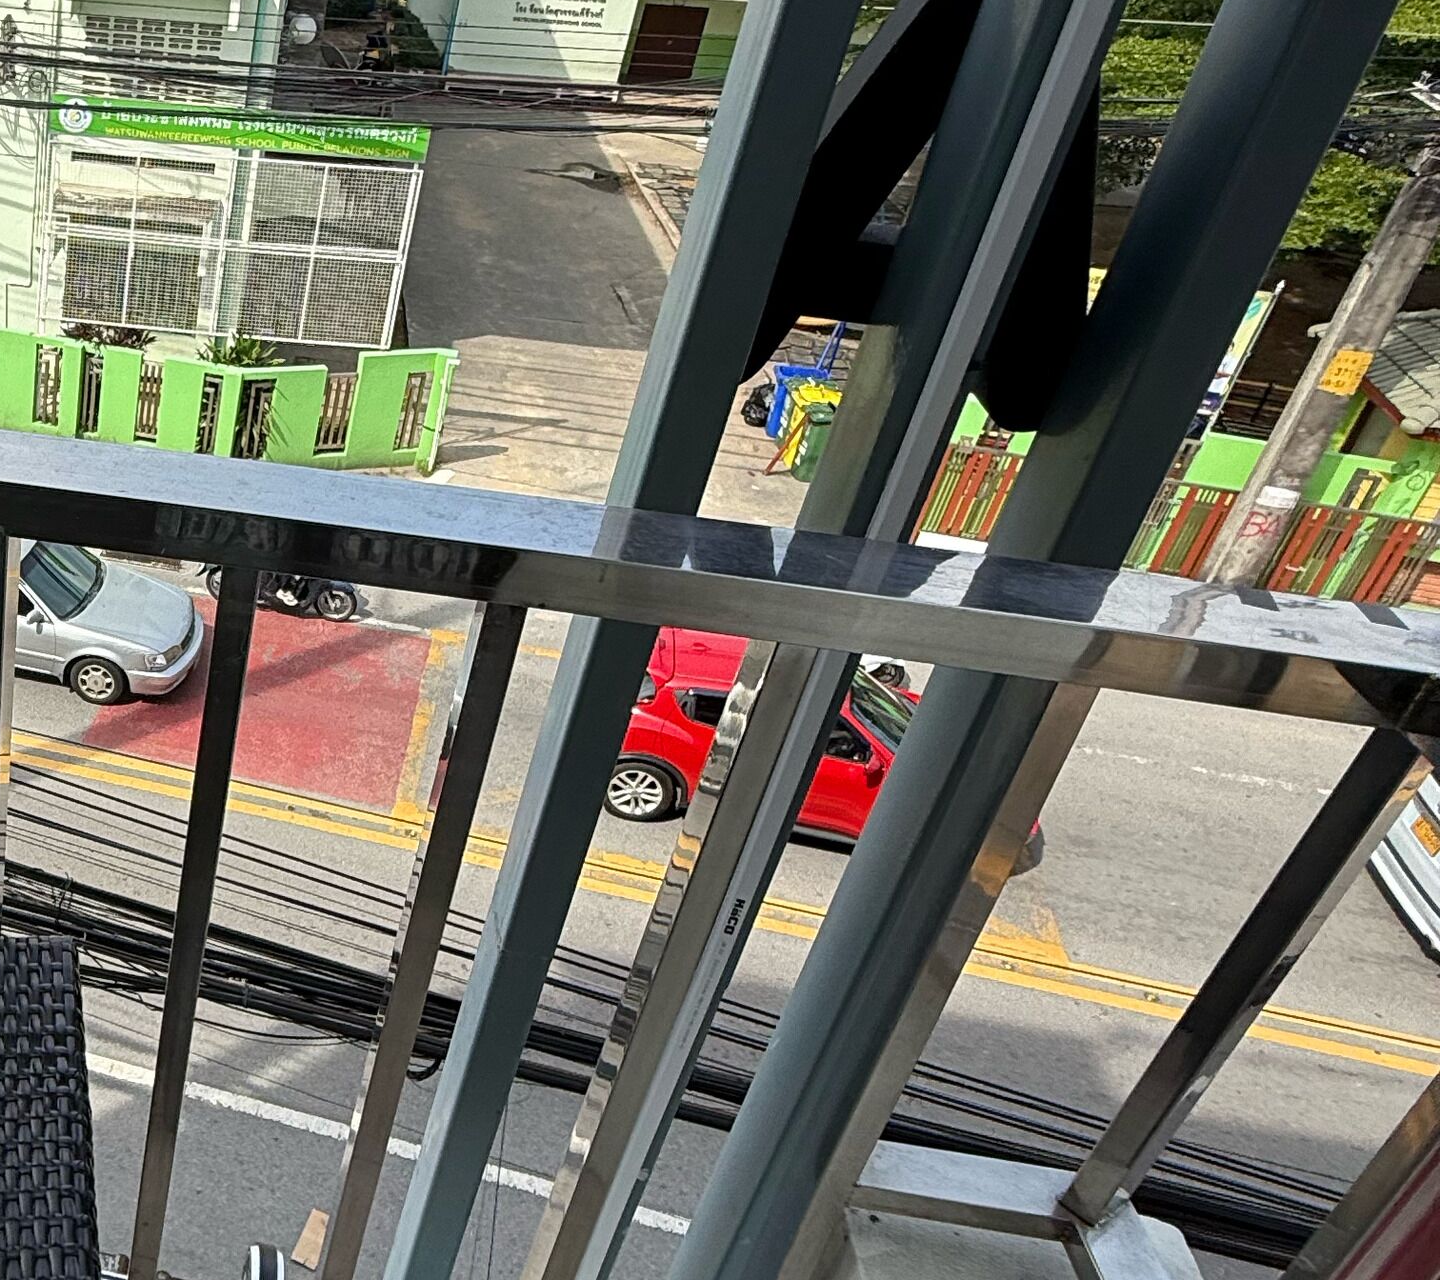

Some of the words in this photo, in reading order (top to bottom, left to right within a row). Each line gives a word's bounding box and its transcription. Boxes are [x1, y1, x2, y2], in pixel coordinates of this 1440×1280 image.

[235, 137, 277, 149] SCHOOL
[281, 140, 323, 152] PUBLIC
[323, 143, 381, 156] RELATIONS
[384, 147, 410, 159] SIGN
